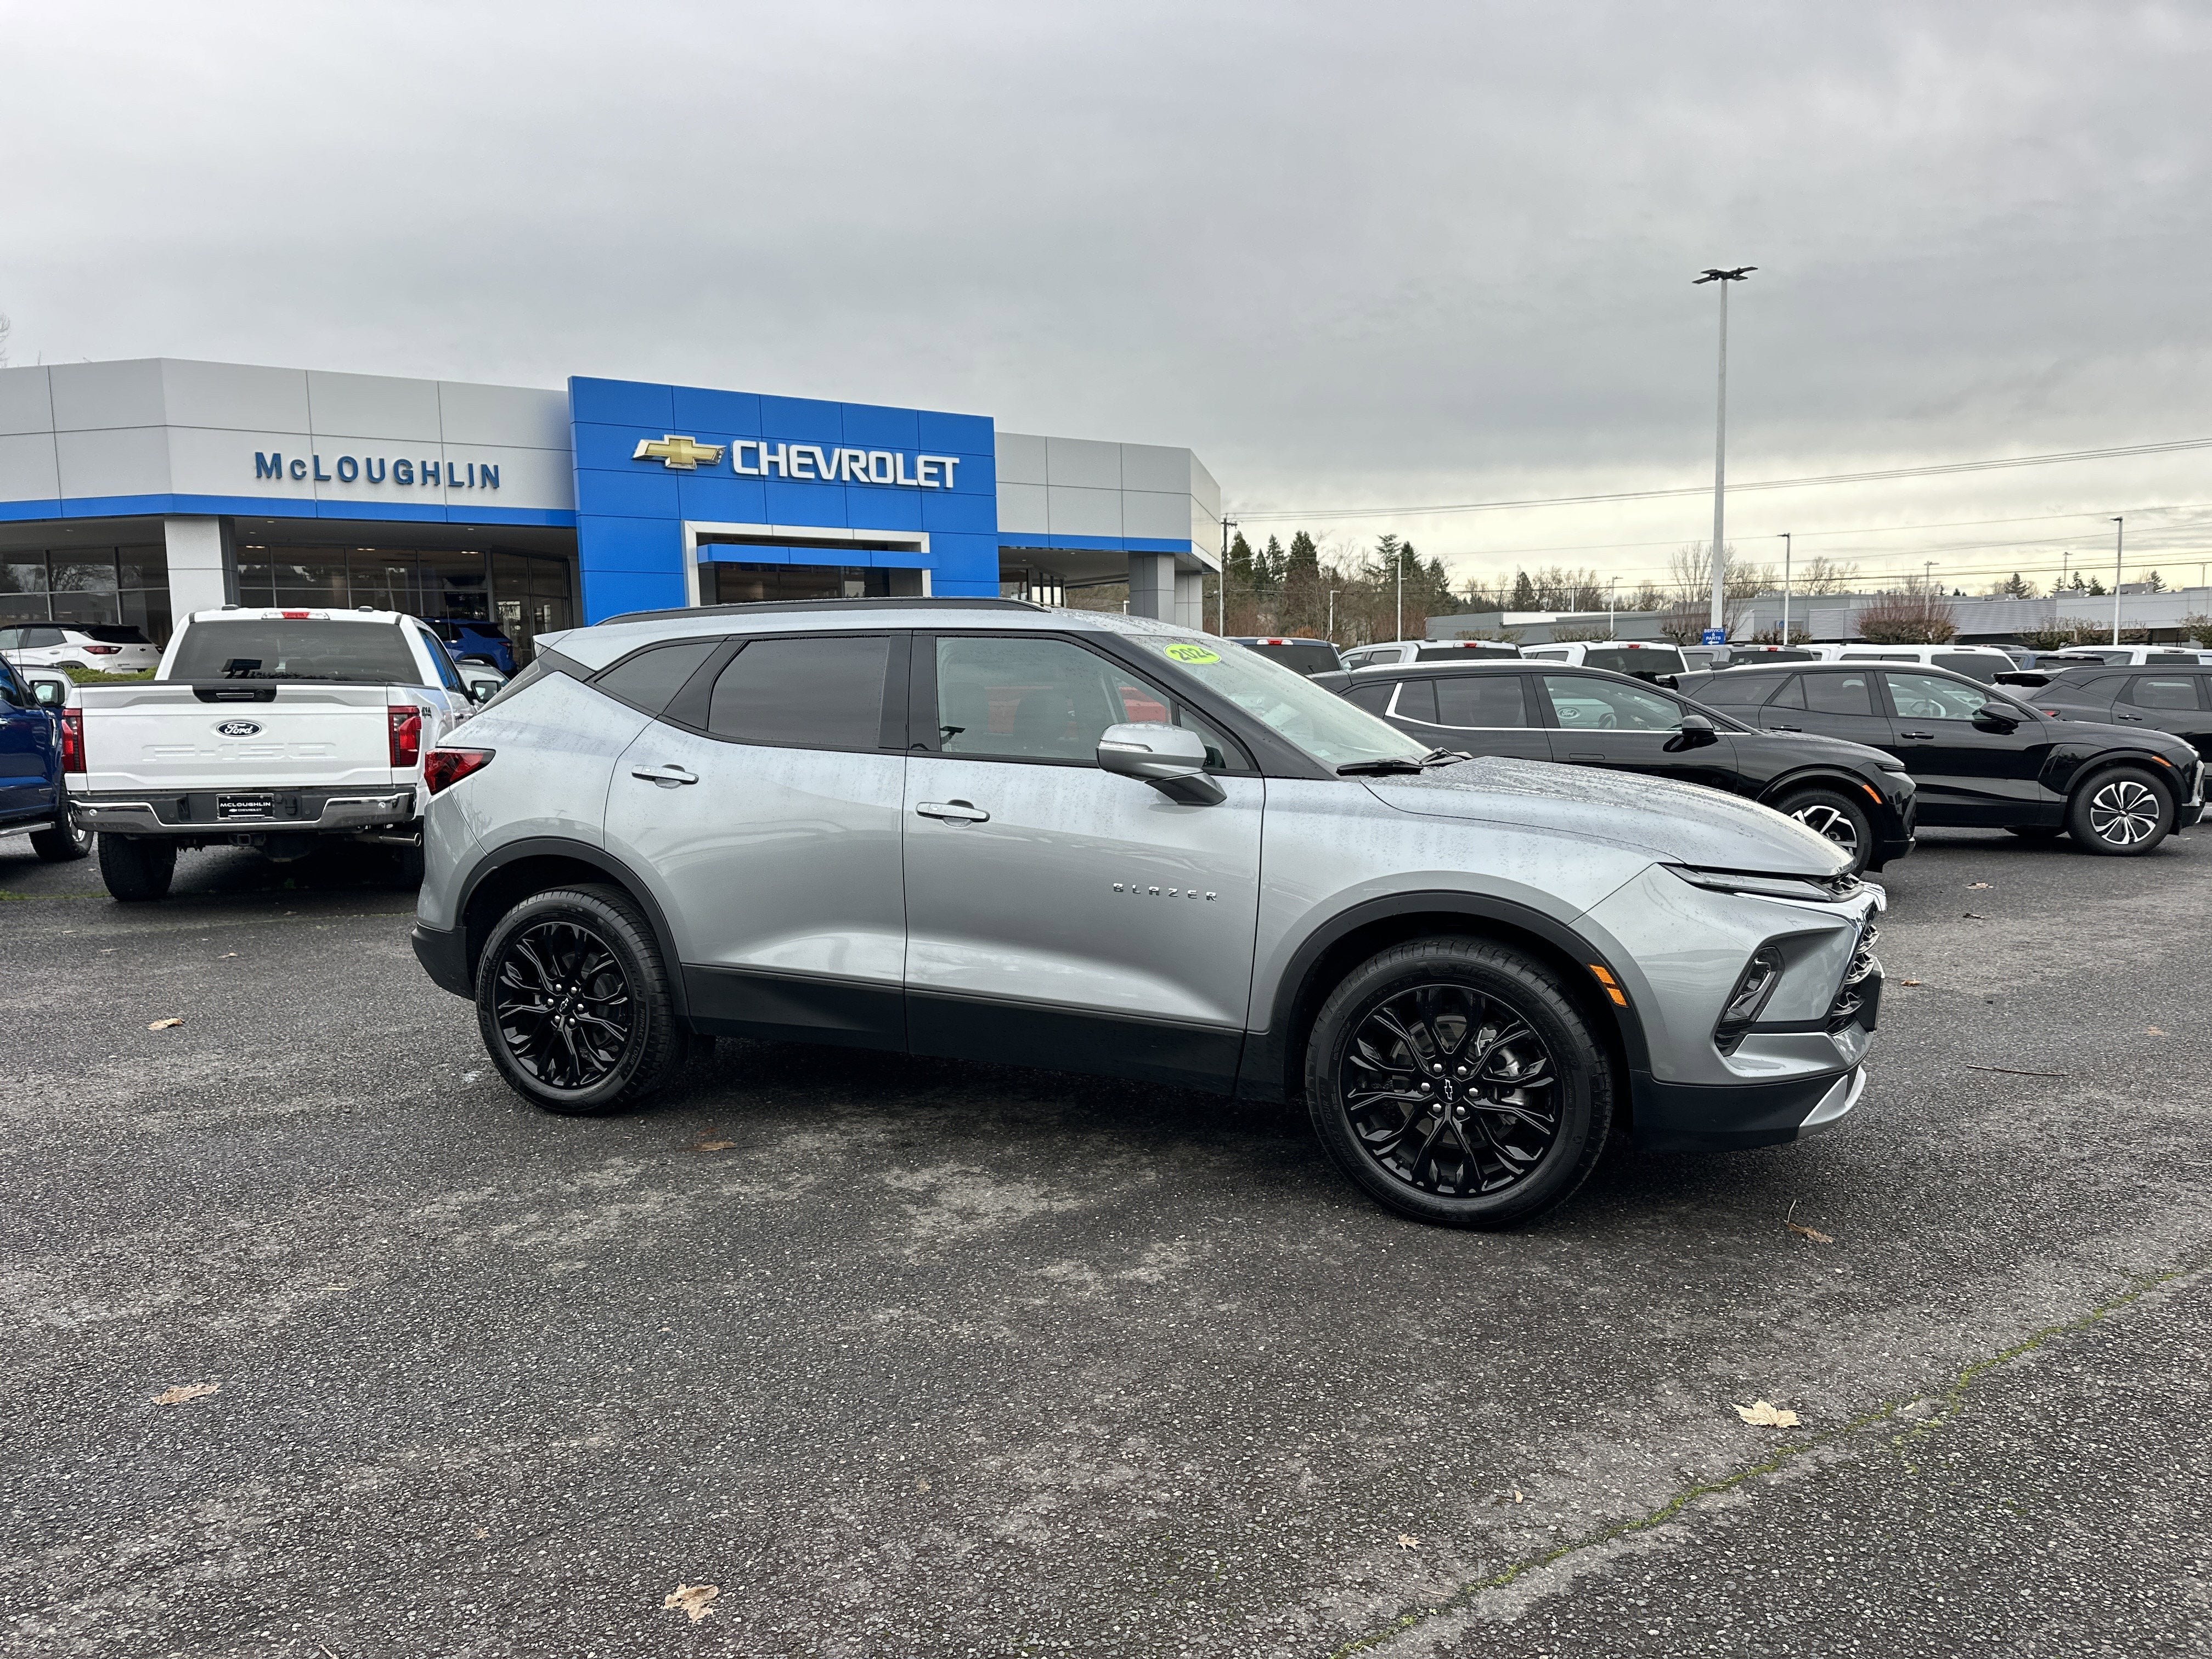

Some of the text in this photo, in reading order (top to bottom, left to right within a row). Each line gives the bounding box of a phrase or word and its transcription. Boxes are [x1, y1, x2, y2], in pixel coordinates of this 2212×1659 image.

[255, 452, 500, 488] McLOUGHLIN
[732, 439, 960, 488] CHEVROLET
[1170, 647, 1217, 661] 2024
[224, 723, 253, 734] Ford
[1113, 883, 1217, 901] BLAZER
[637, 1008, 646, 1044] PRIMACY
[629, 1045, 640, 1065] TOUR
[1323, 1101, 1335, 1125] TOUR
